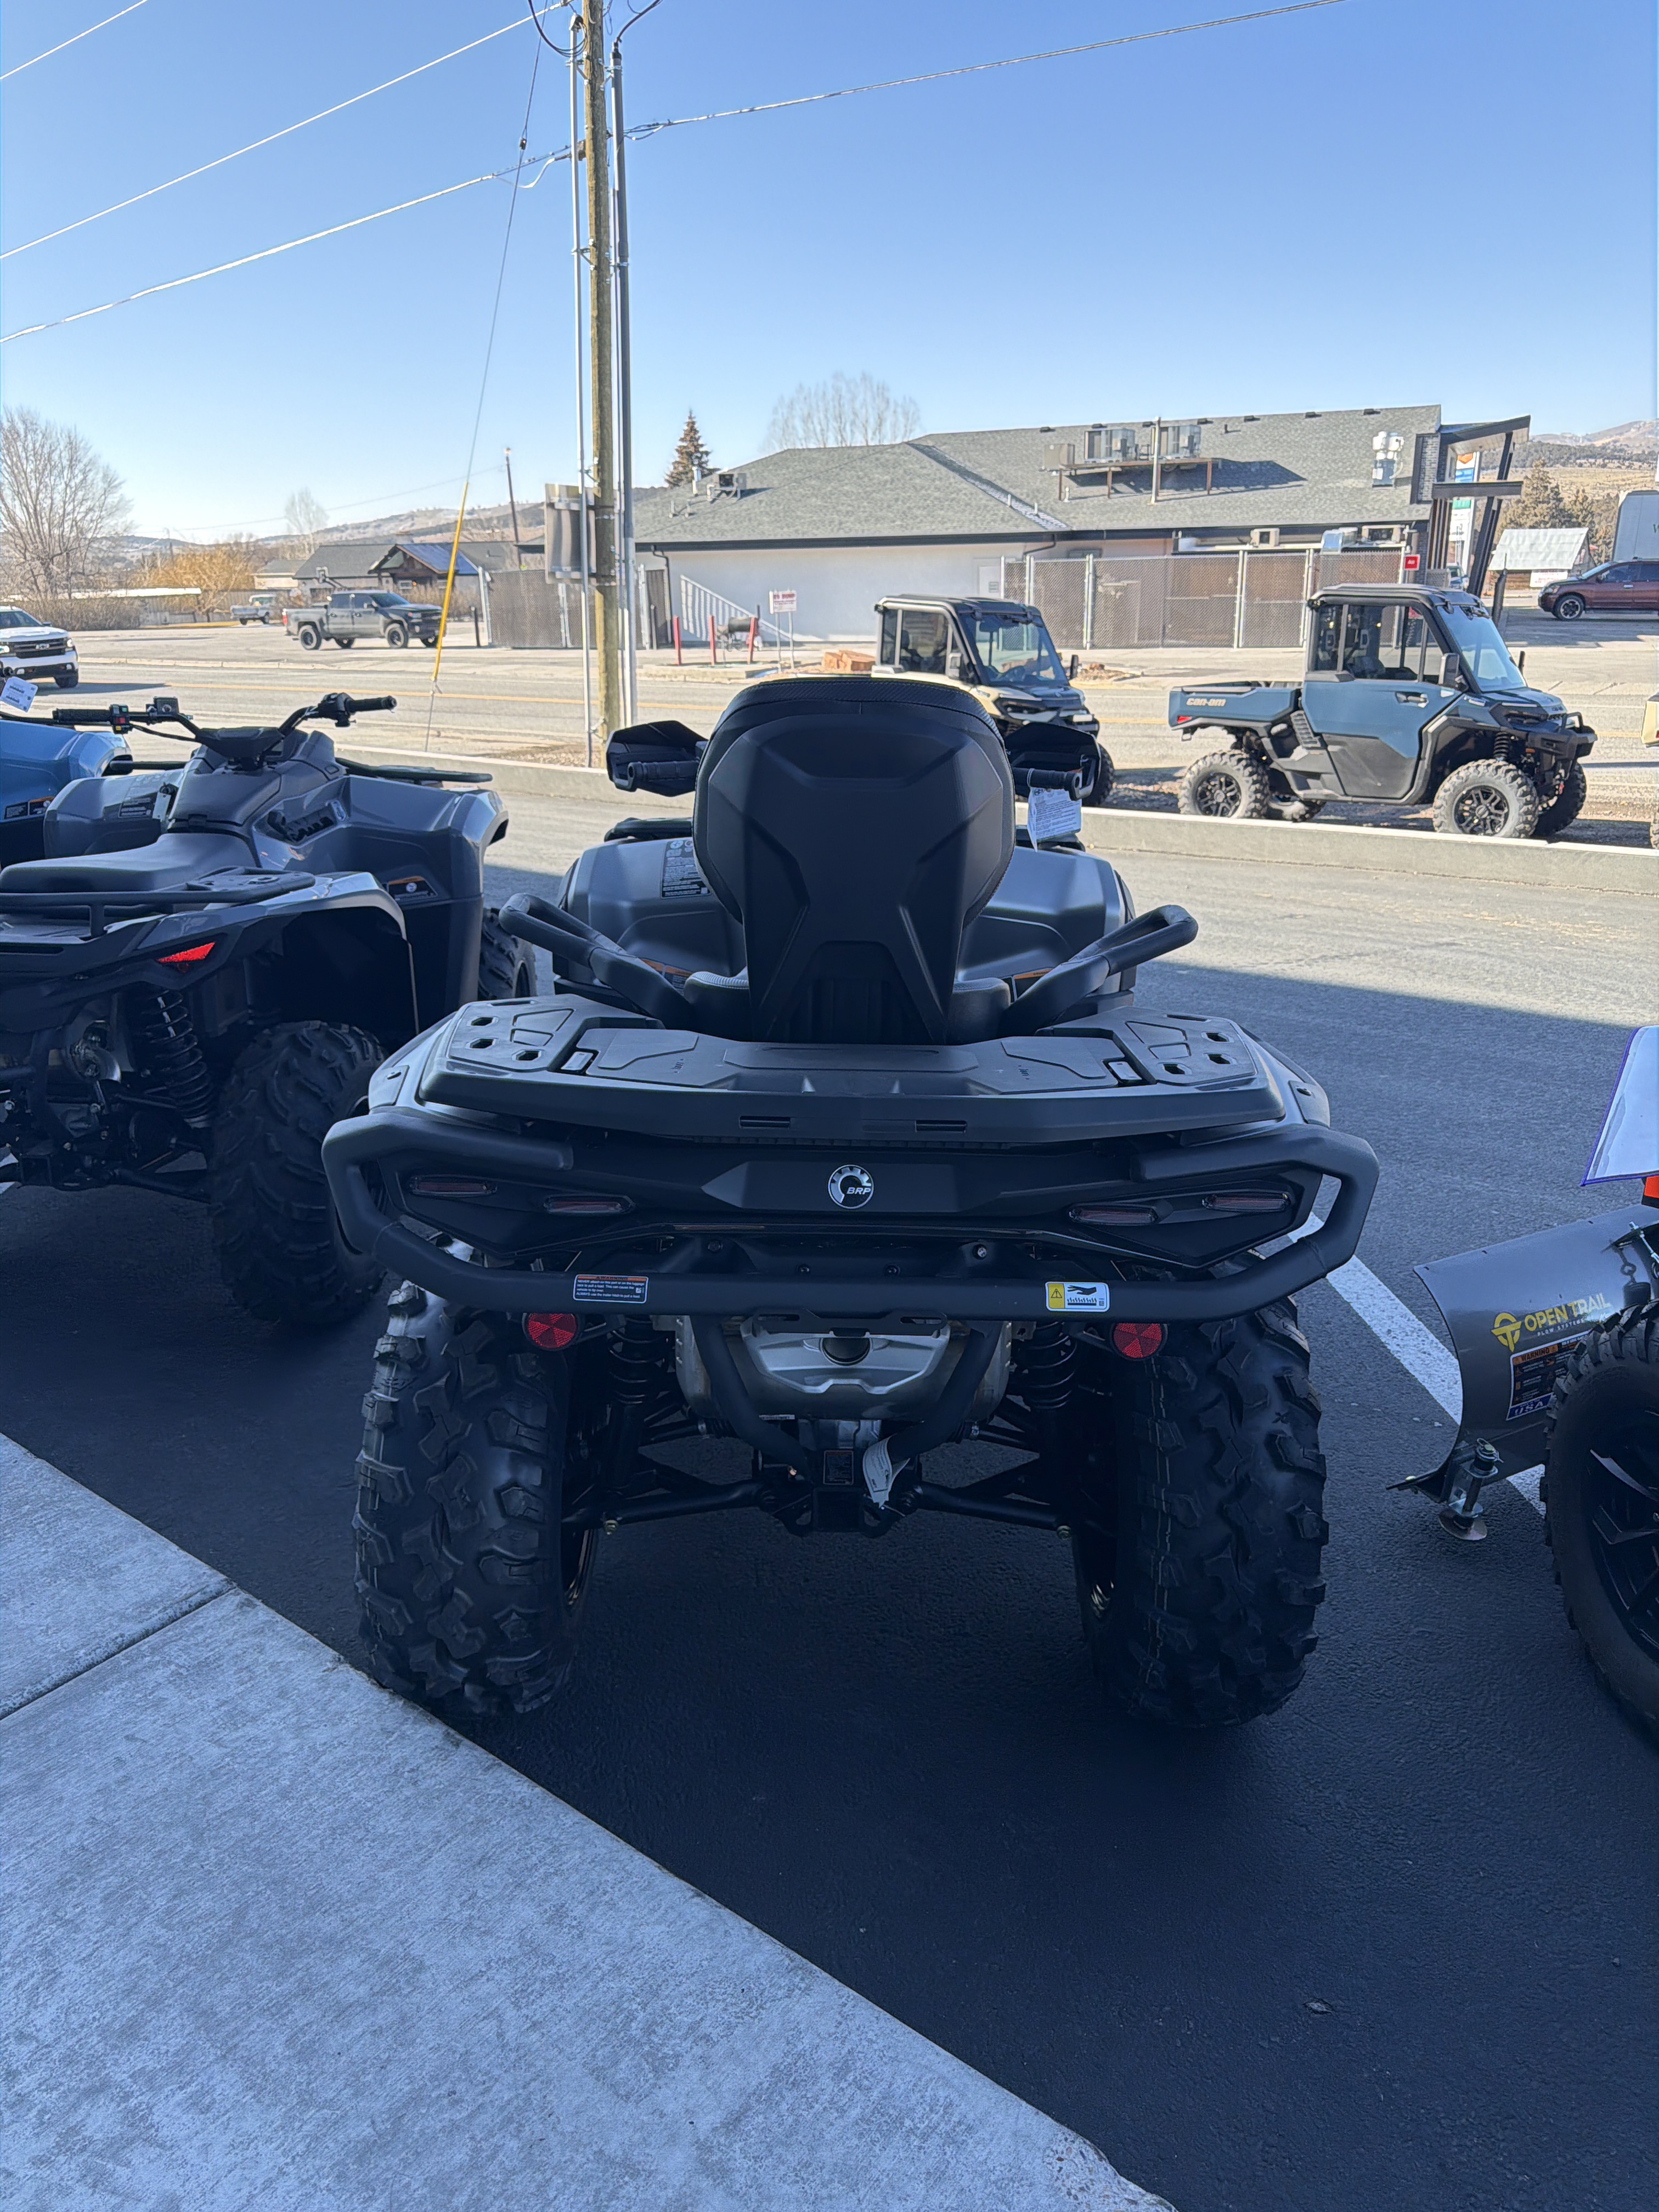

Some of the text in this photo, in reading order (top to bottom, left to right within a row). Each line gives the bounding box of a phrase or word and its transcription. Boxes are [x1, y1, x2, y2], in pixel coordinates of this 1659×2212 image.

[847, 1187, 871, 1195] BRP
[1525, 1305, 1568, 1331] OPEN
[1567, 1293, 1612, 1318] TRAIL
[1537, 1318, 1585, 1337] PLOW SYSTEMS
[1521, 1347, 1550, 1361] WARNING
[1514, 1401, 1544, 1415] USA
